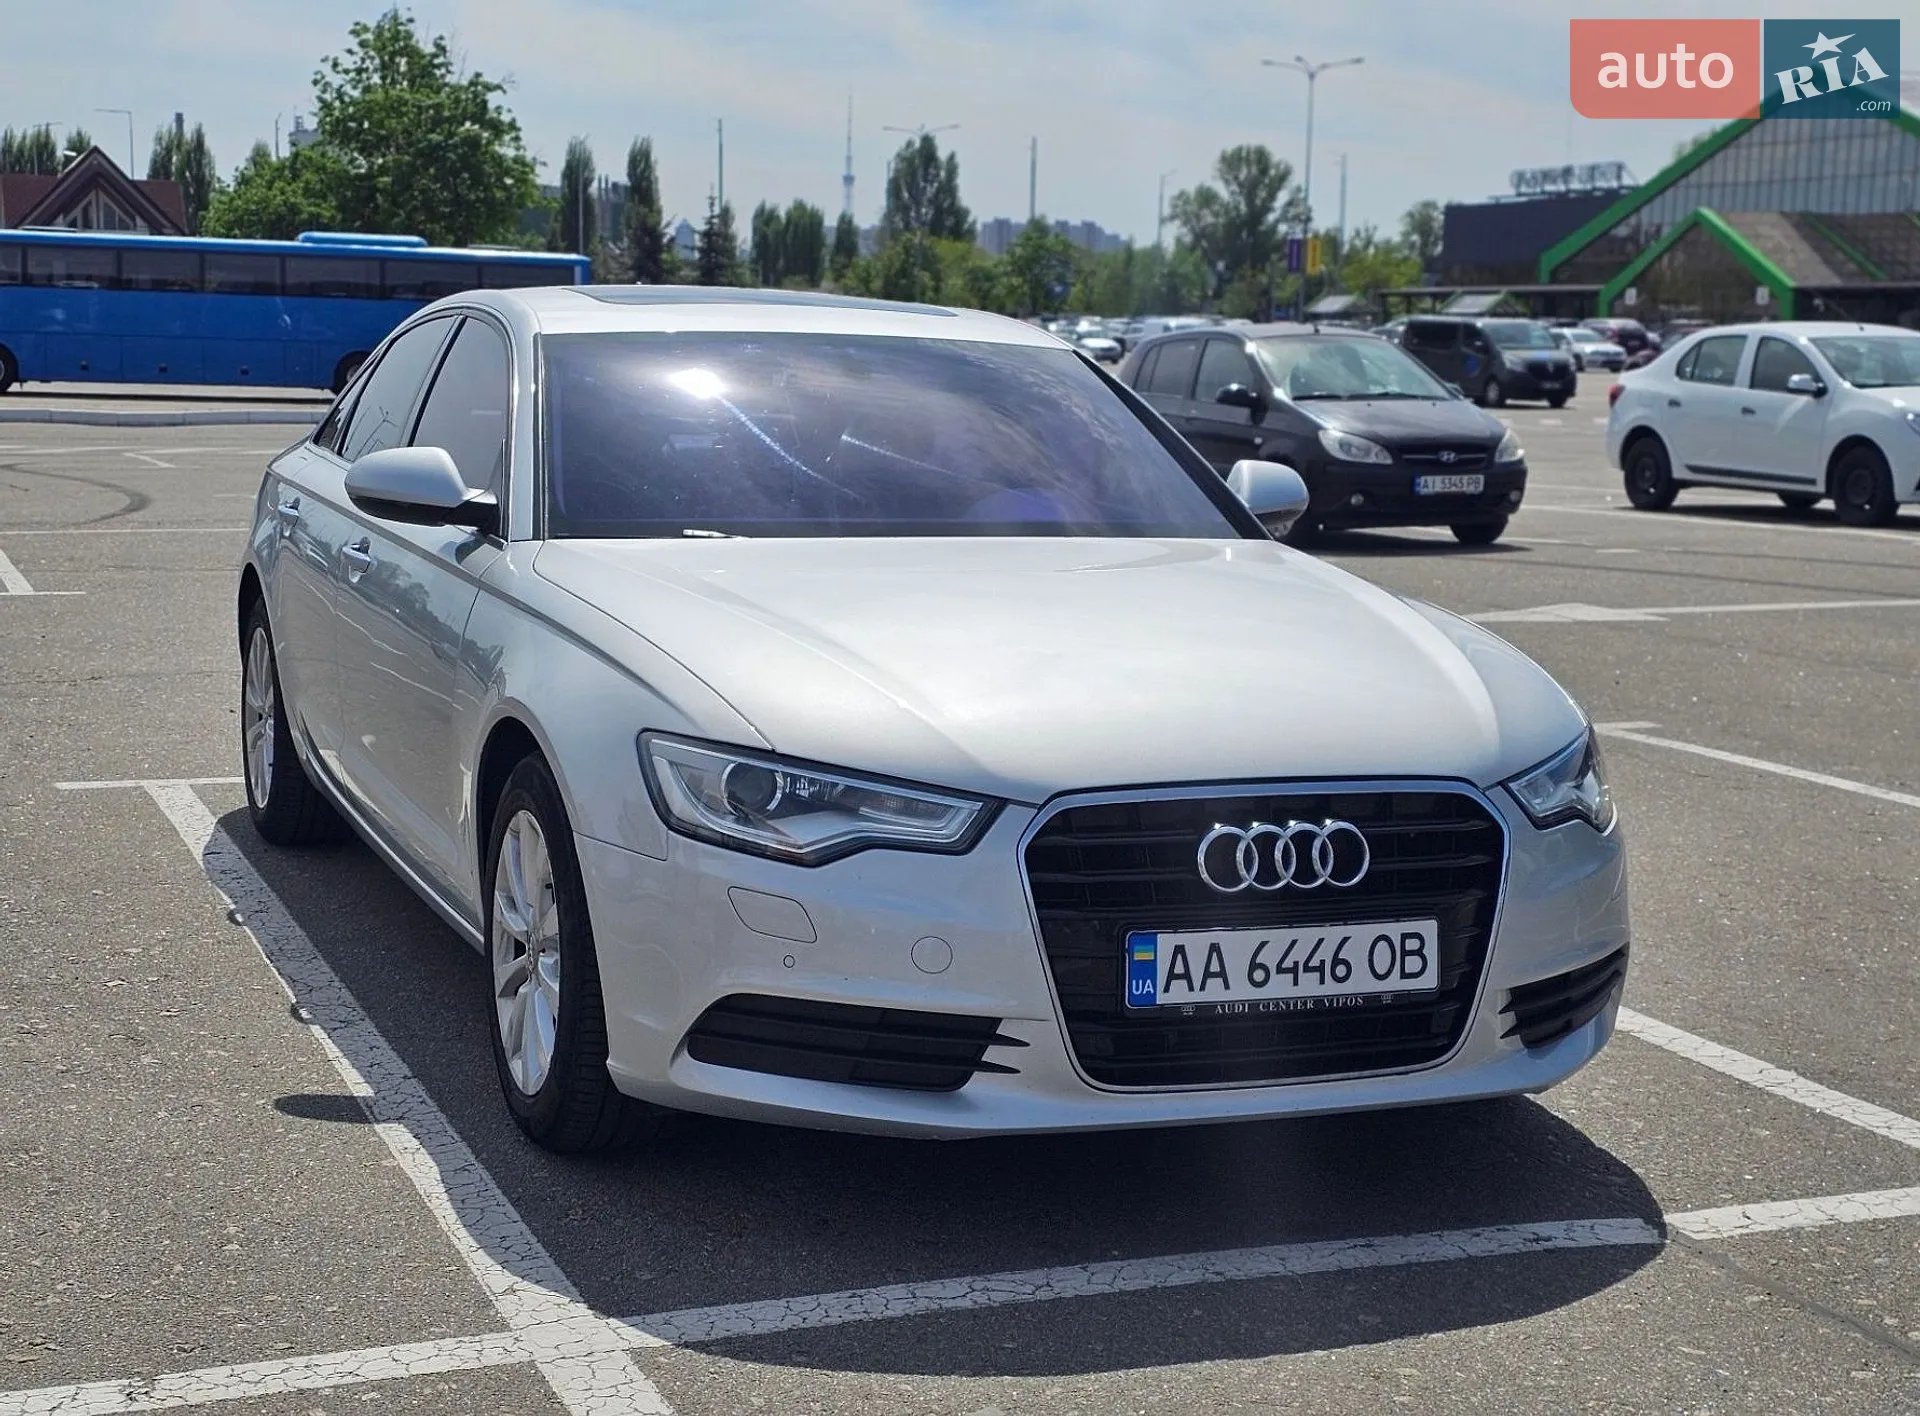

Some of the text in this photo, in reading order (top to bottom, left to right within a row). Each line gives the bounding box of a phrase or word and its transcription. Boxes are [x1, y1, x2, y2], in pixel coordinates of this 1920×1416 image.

[1162, 931, 1429, 994] AA 6446 OB
[1132, 979, 1155, 996] UA
[1215, 995, 1364, 1015] AUDI CENTER VIPOS
